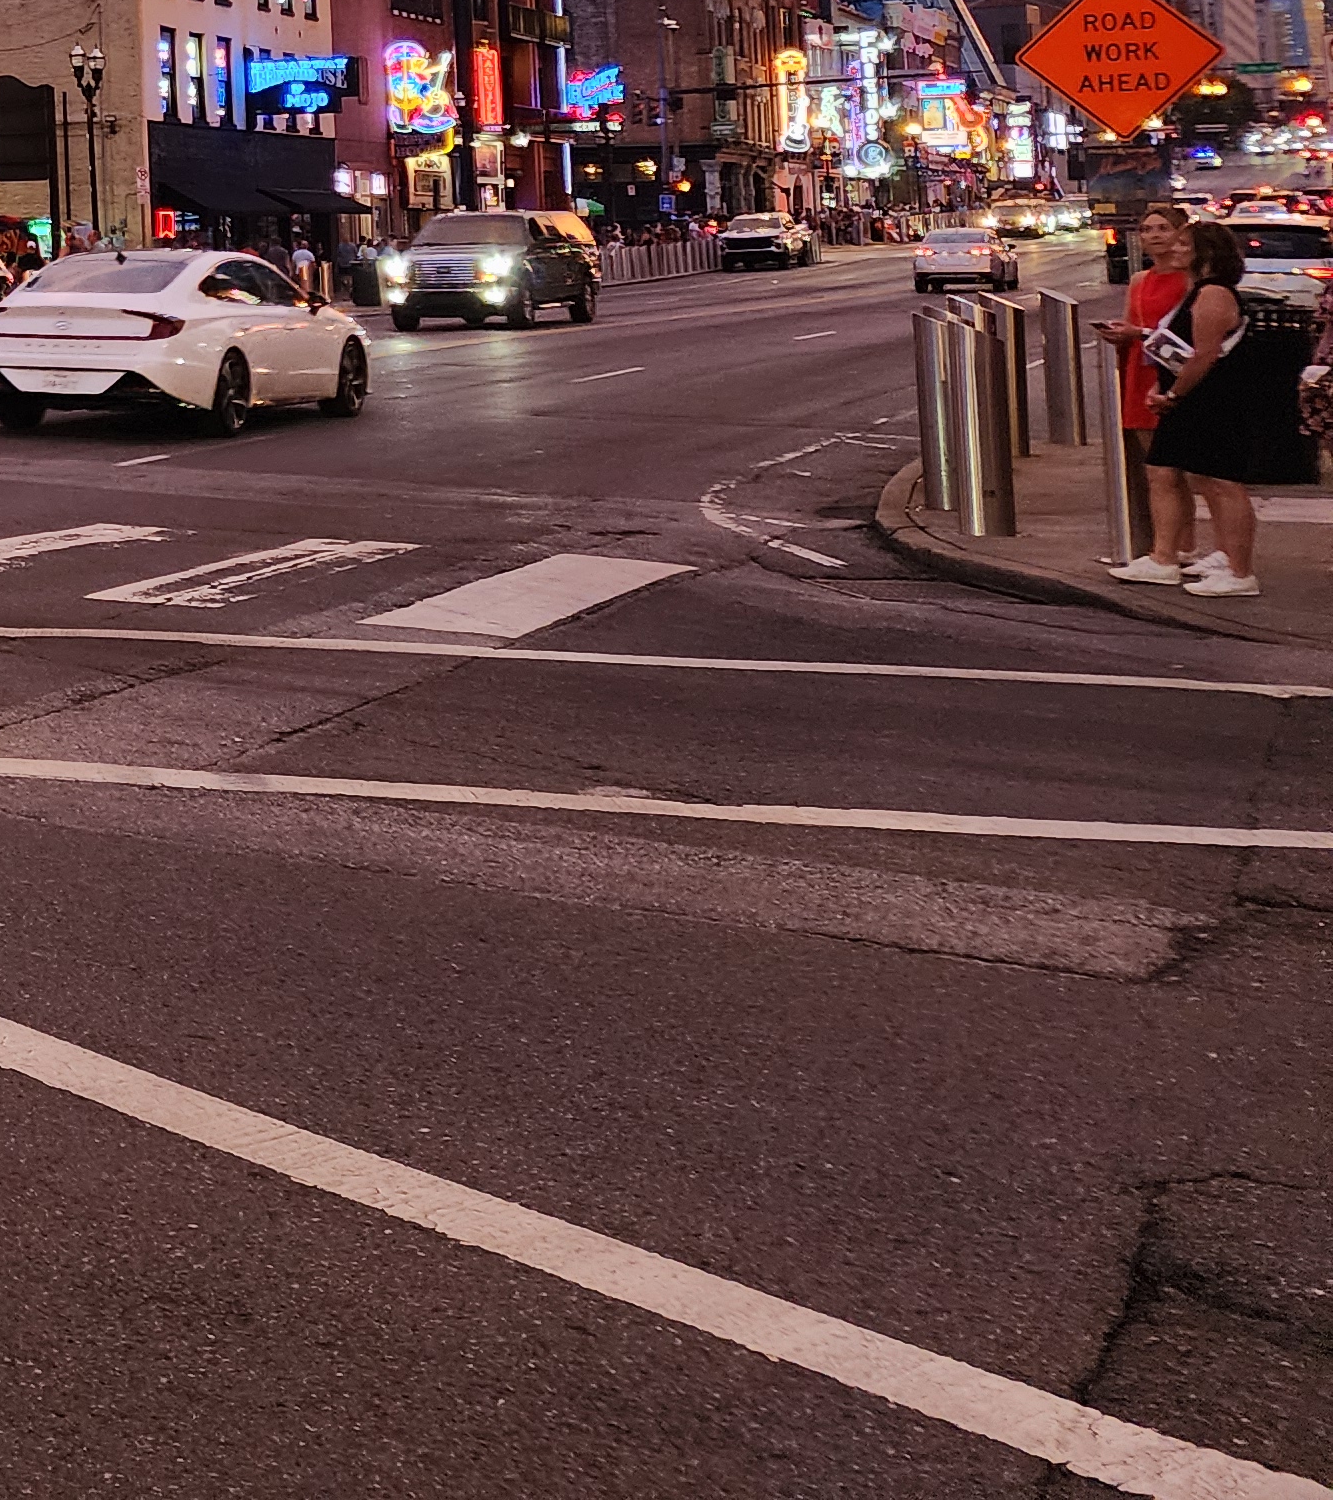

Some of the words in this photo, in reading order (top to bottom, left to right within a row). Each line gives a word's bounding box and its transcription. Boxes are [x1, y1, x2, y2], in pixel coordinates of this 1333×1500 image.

[1083, 11, 1156, 32] ROAD
[1083, 41, 1160, 63] WORK
[1077, 72, 1171, 94] AHEAD
[284, 92, 329, 113] MOJO
